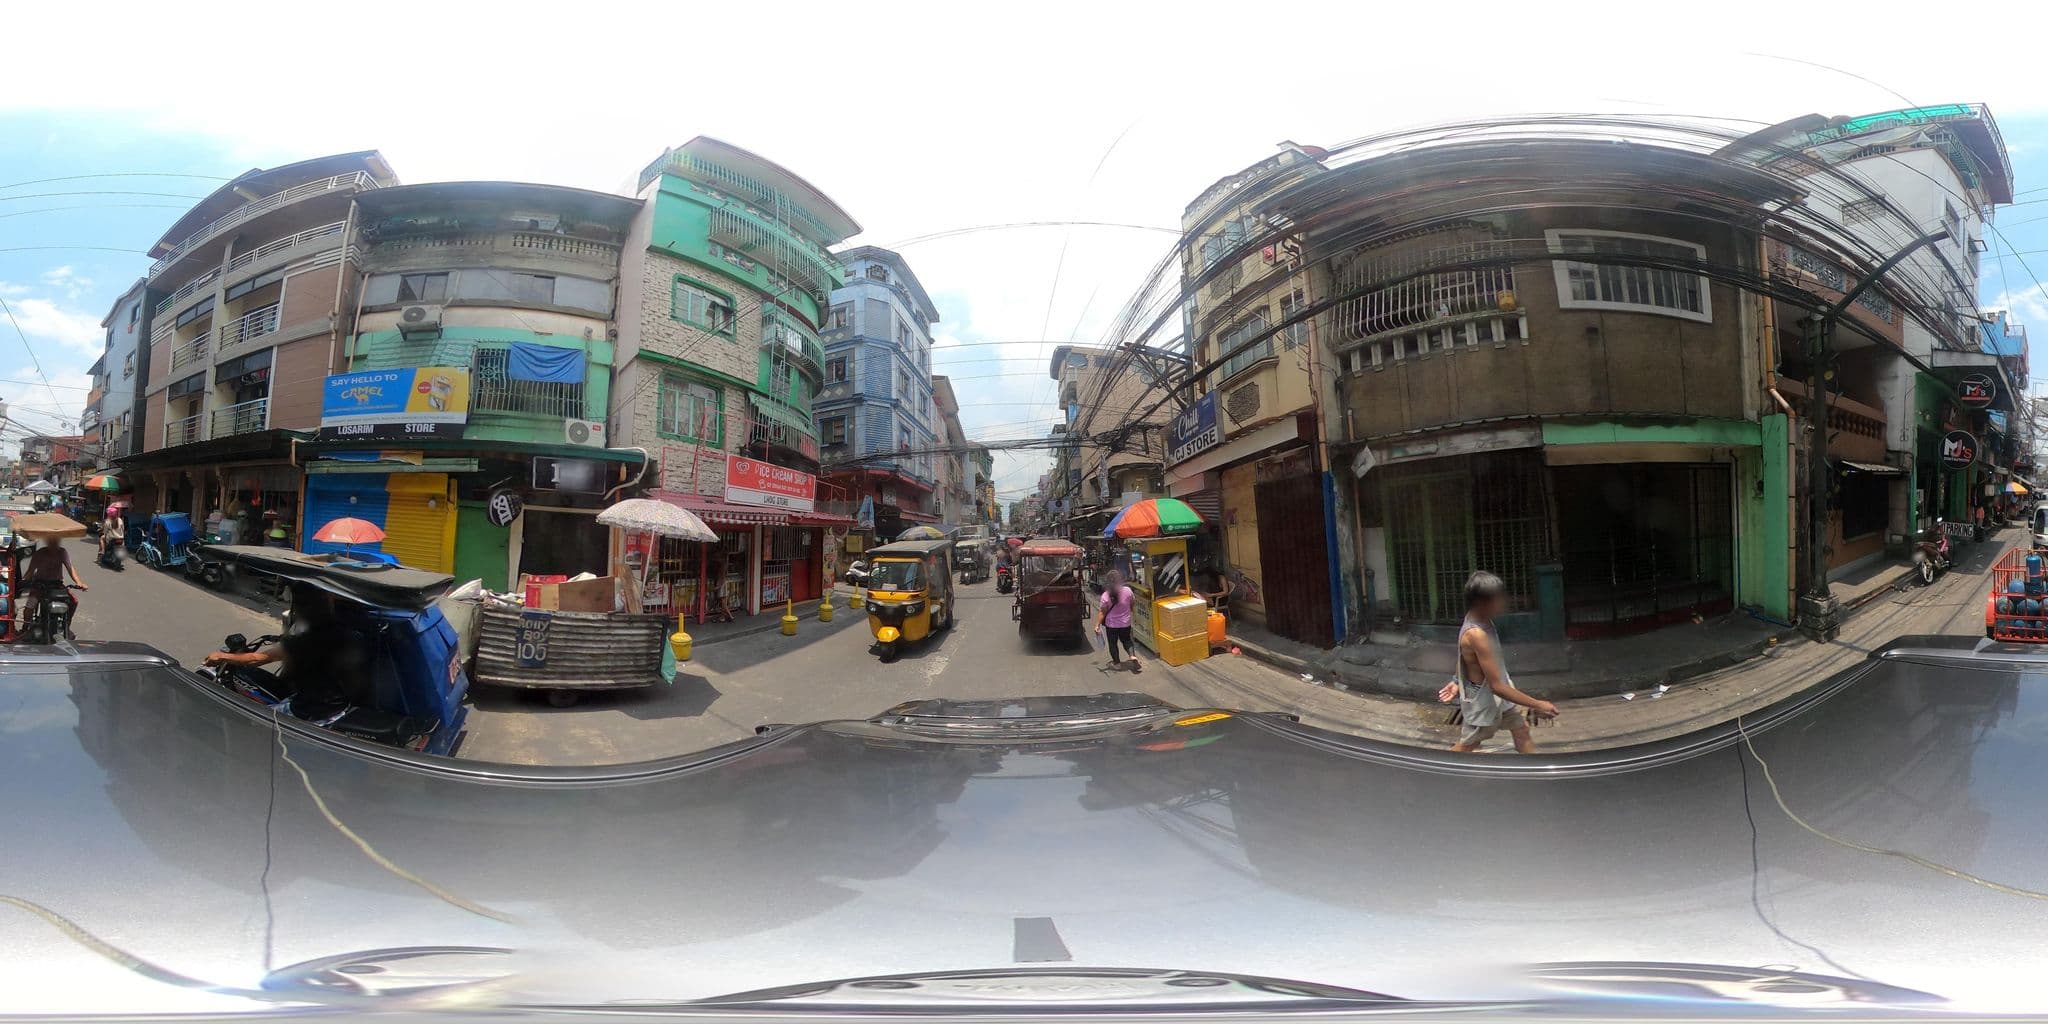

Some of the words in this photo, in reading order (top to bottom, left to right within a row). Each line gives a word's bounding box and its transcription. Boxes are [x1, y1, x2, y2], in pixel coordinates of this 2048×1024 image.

[331, 378, 350, 387] SAY
[351, 375, 382, 384] HELLO
[384, 374, 398, 382] TO
[341, 386, 384, 399] CAMEL
[338, 425, 374, 435] LOSARIM
[405, 424, 435, 433] STORE
[1175, 445, 1185, 461] CJ
[1186, 429, 1216, 456] STORE
[1946, 523, 1973, 536] PARKING
[517, 643, 547, 661] 105
